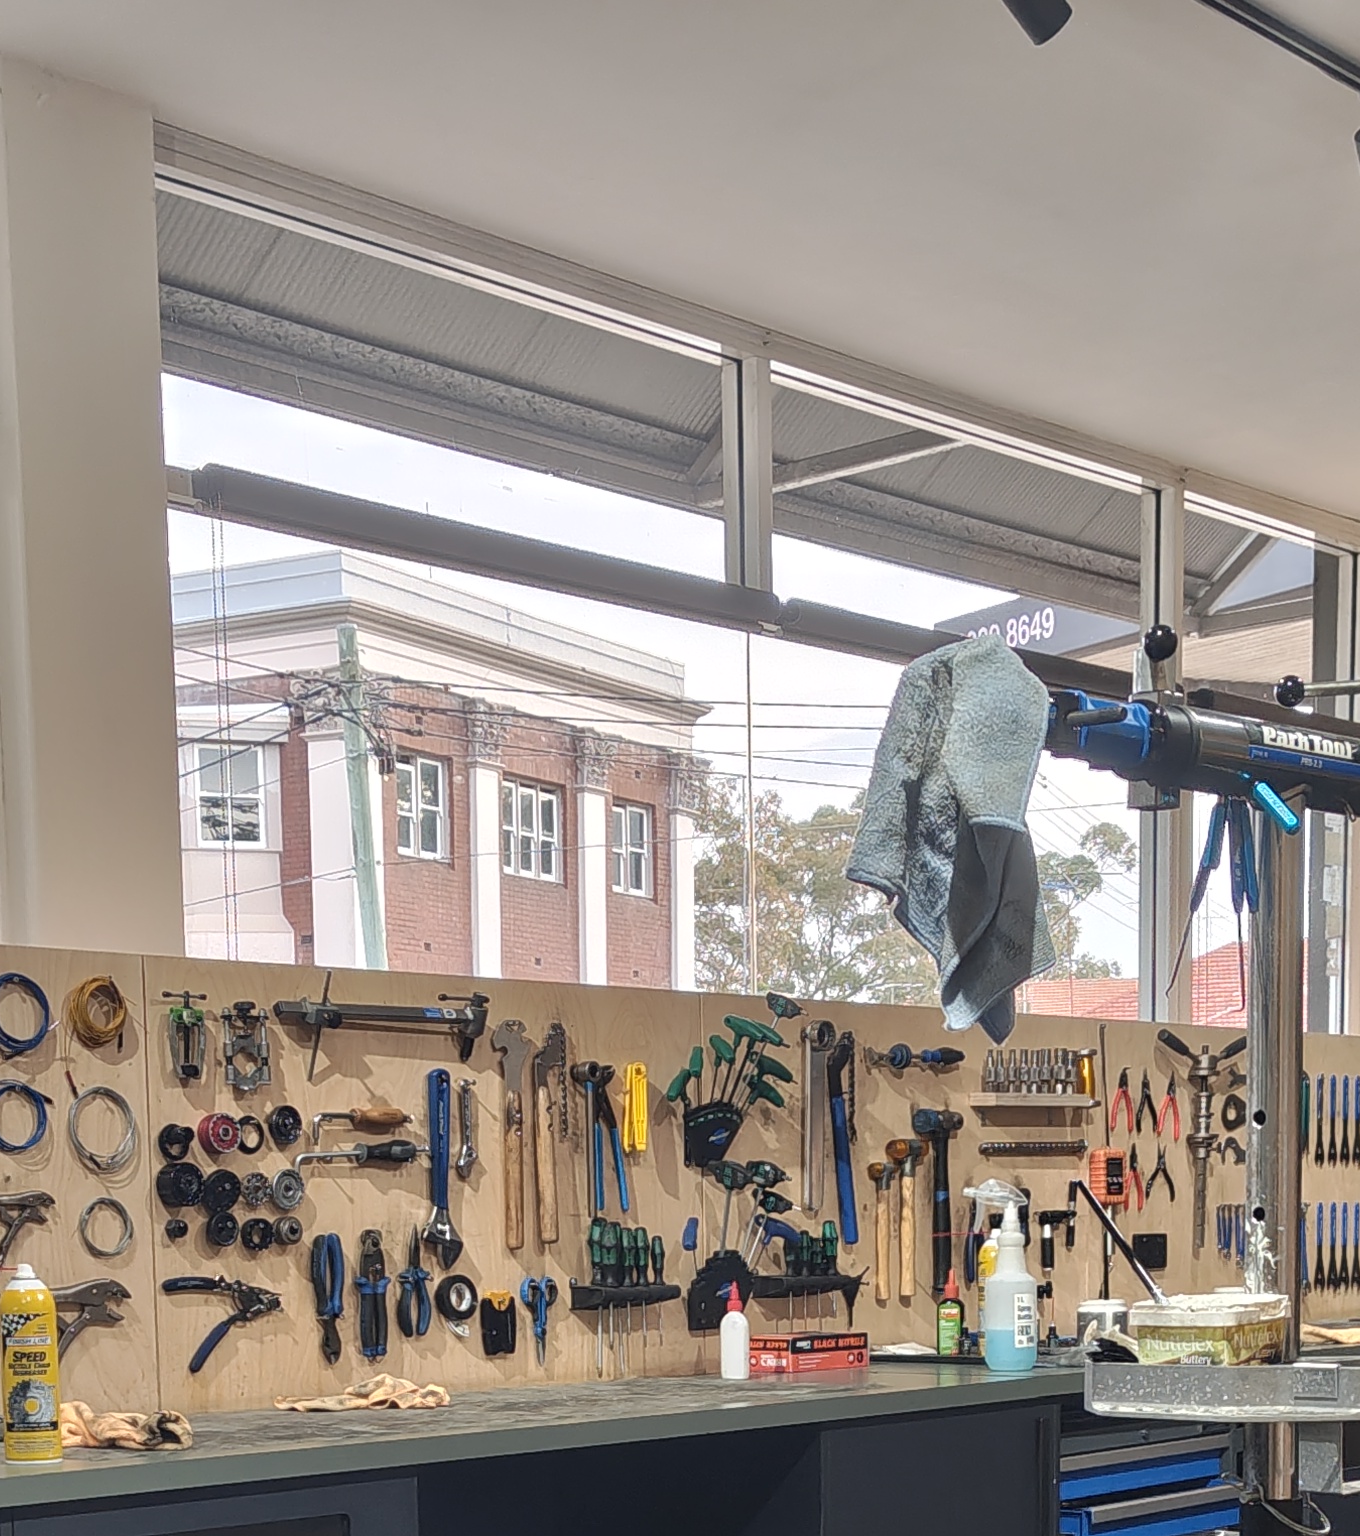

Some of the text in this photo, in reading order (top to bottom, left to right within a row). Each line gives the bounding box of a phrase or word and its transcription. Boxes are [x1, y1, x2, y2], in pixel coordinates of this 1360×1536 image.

[1006, 607, 1055, 648] 8649
[1146, 1333, 1215, 1352] Nuttelex
[12, 1351, 46, 1362] SPEED
[1180, 1354, 1212, 1367] Buttery
